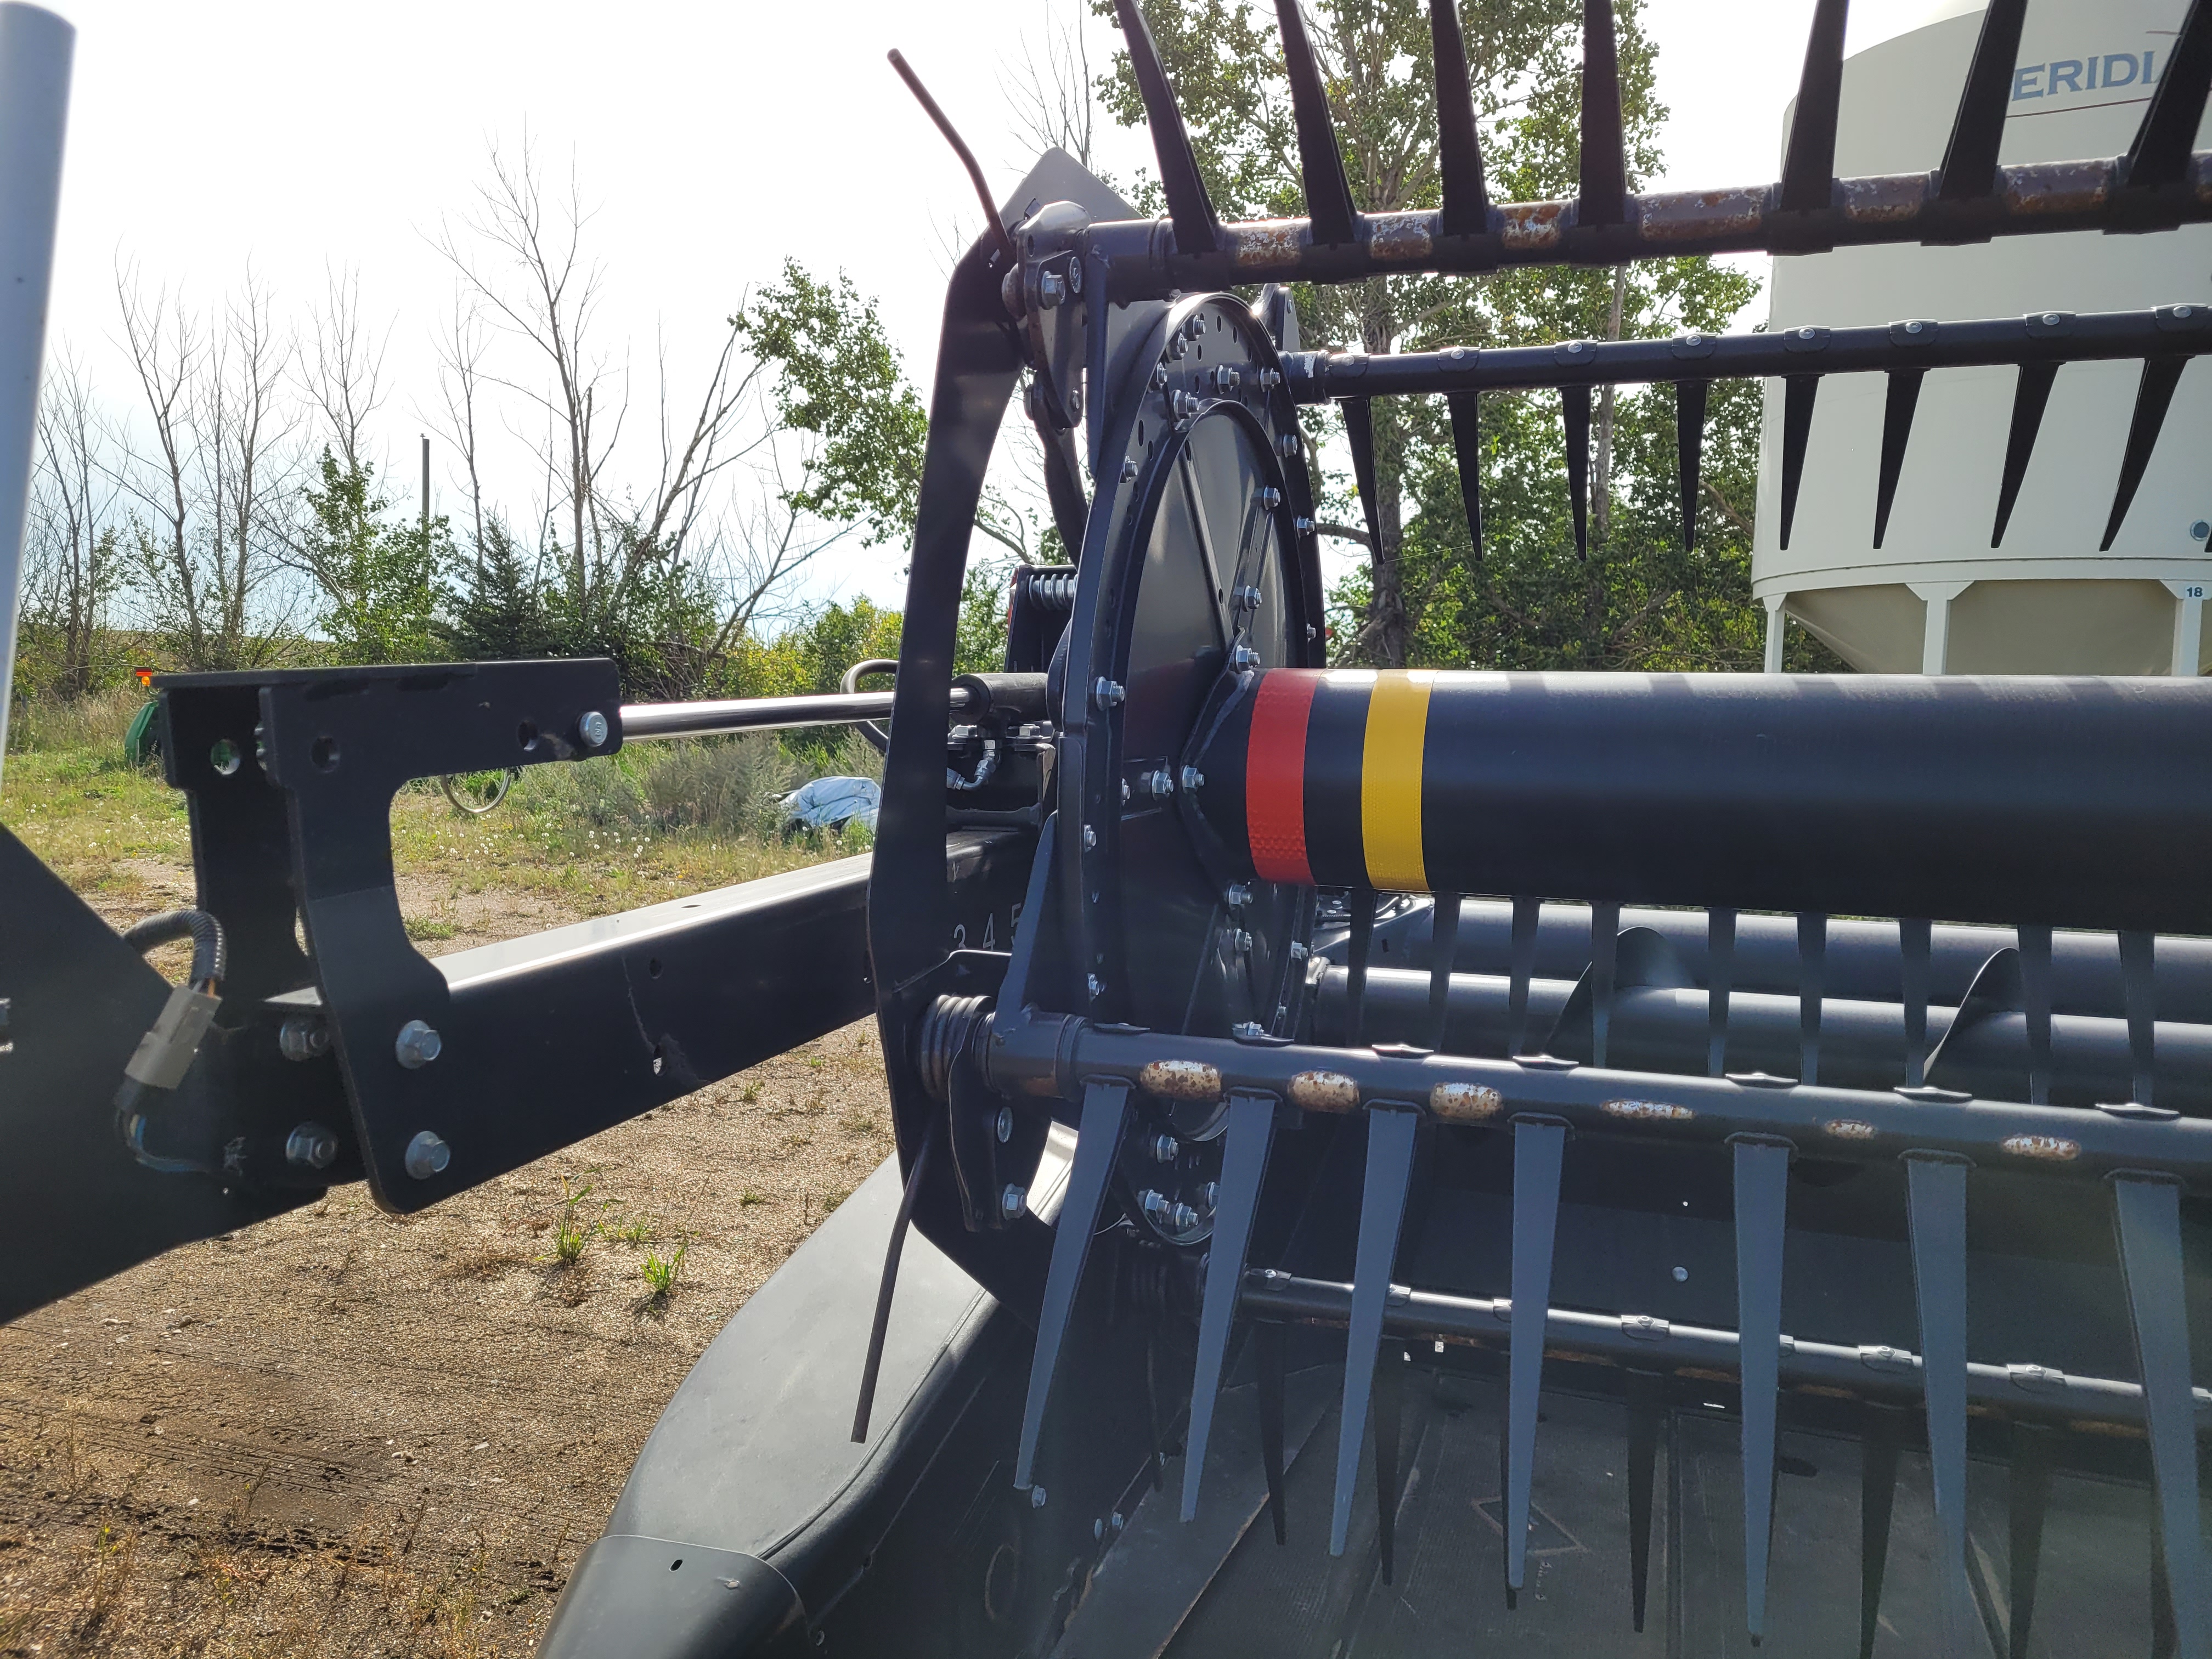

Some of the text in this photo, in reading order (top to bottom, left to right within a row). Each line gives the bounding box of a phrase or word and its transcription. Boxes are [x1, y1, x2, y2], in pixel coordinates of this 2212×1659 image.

[2011, 50, 2160, 101] ERIDI
[2186, 586, 2203, 597] 18
[983, 912, 996, 950] 4
